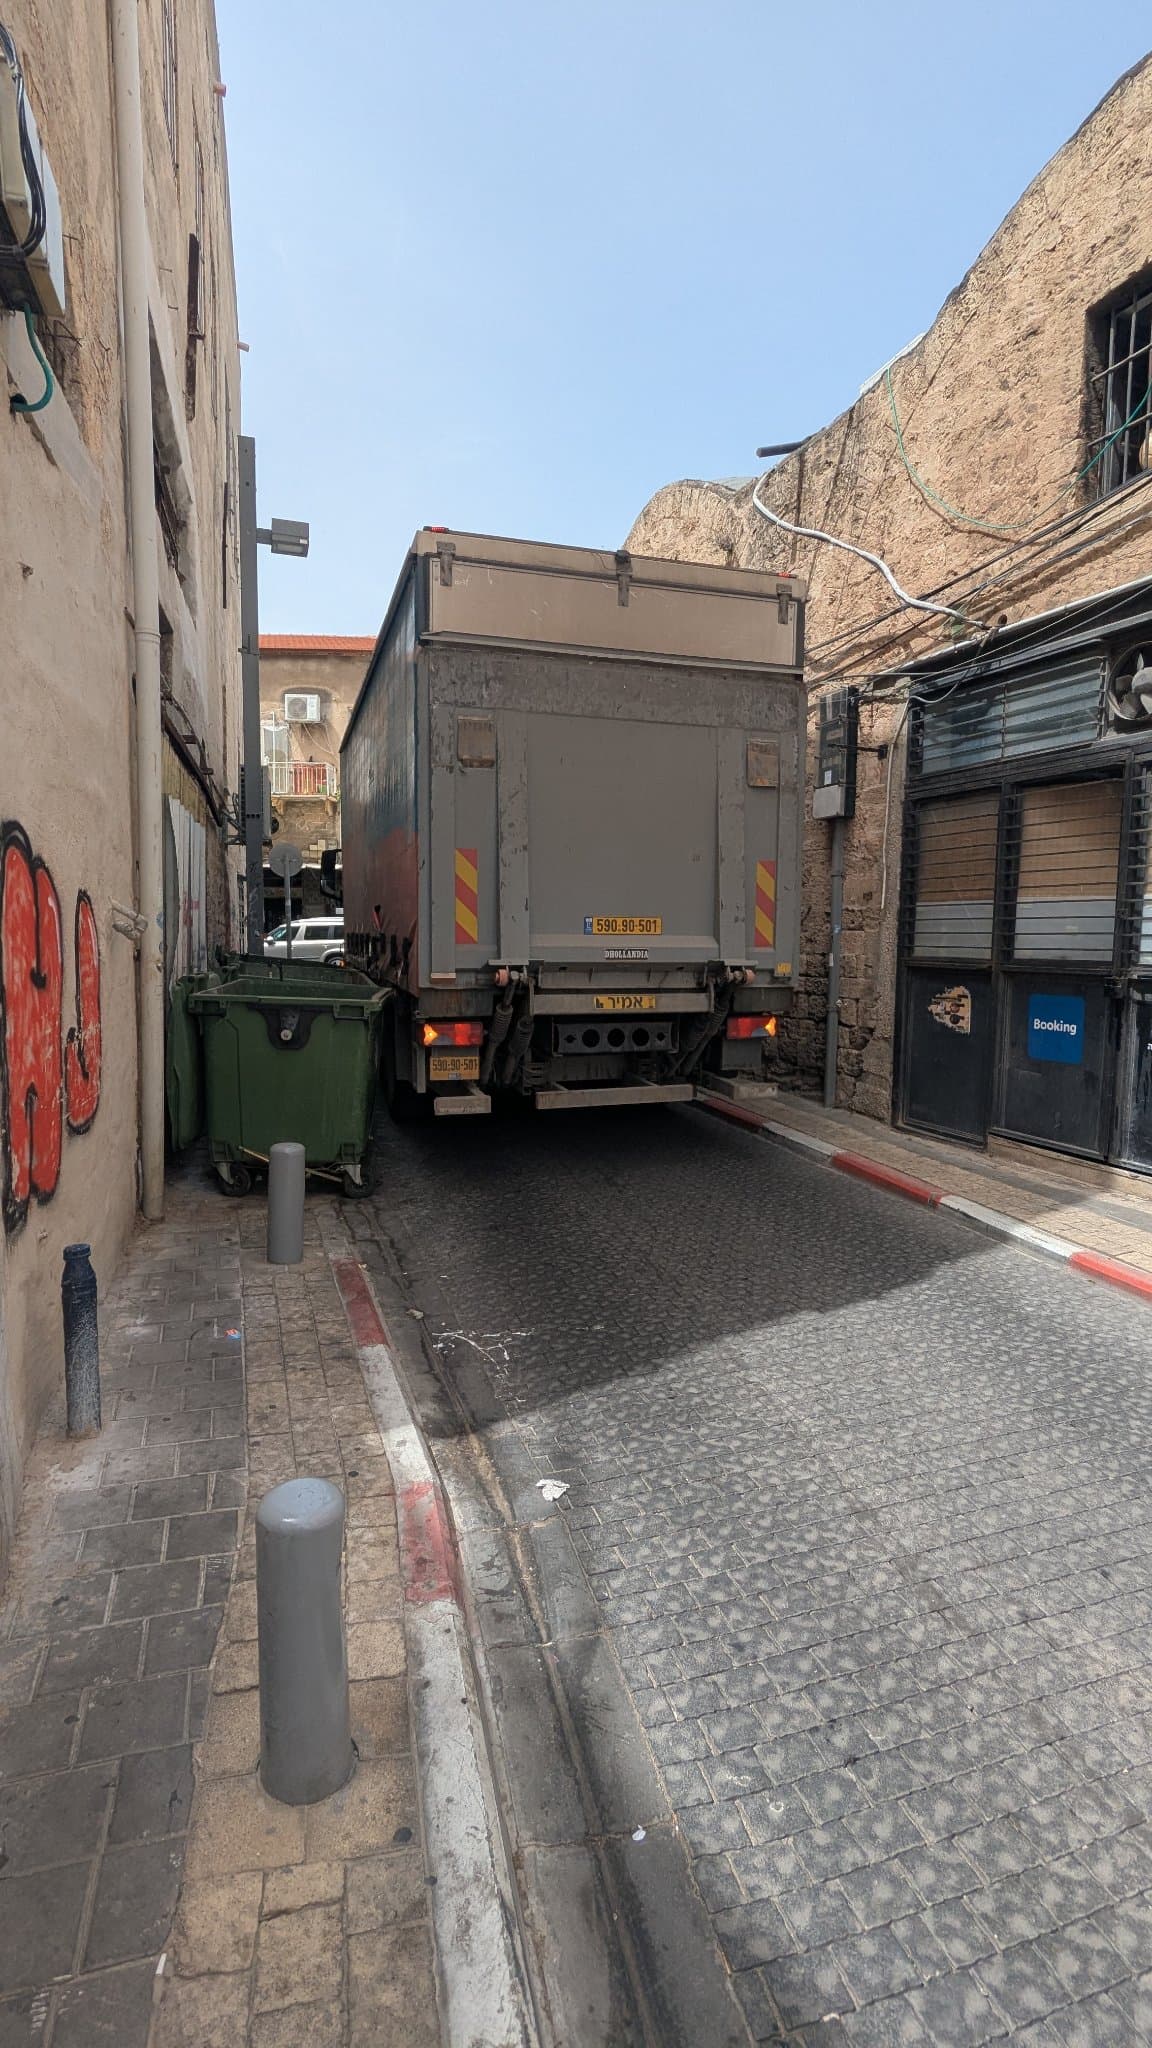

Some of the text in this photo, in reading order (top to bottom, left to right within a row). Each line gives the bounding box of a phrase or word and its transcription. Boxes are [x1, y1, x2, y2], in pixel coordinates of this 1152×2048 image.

[604, 950, 649, 959] DHOLLANDIA
[608, 996, 643, 1009] אמיר
[1033, 1018, 1077, 1036] Booking
